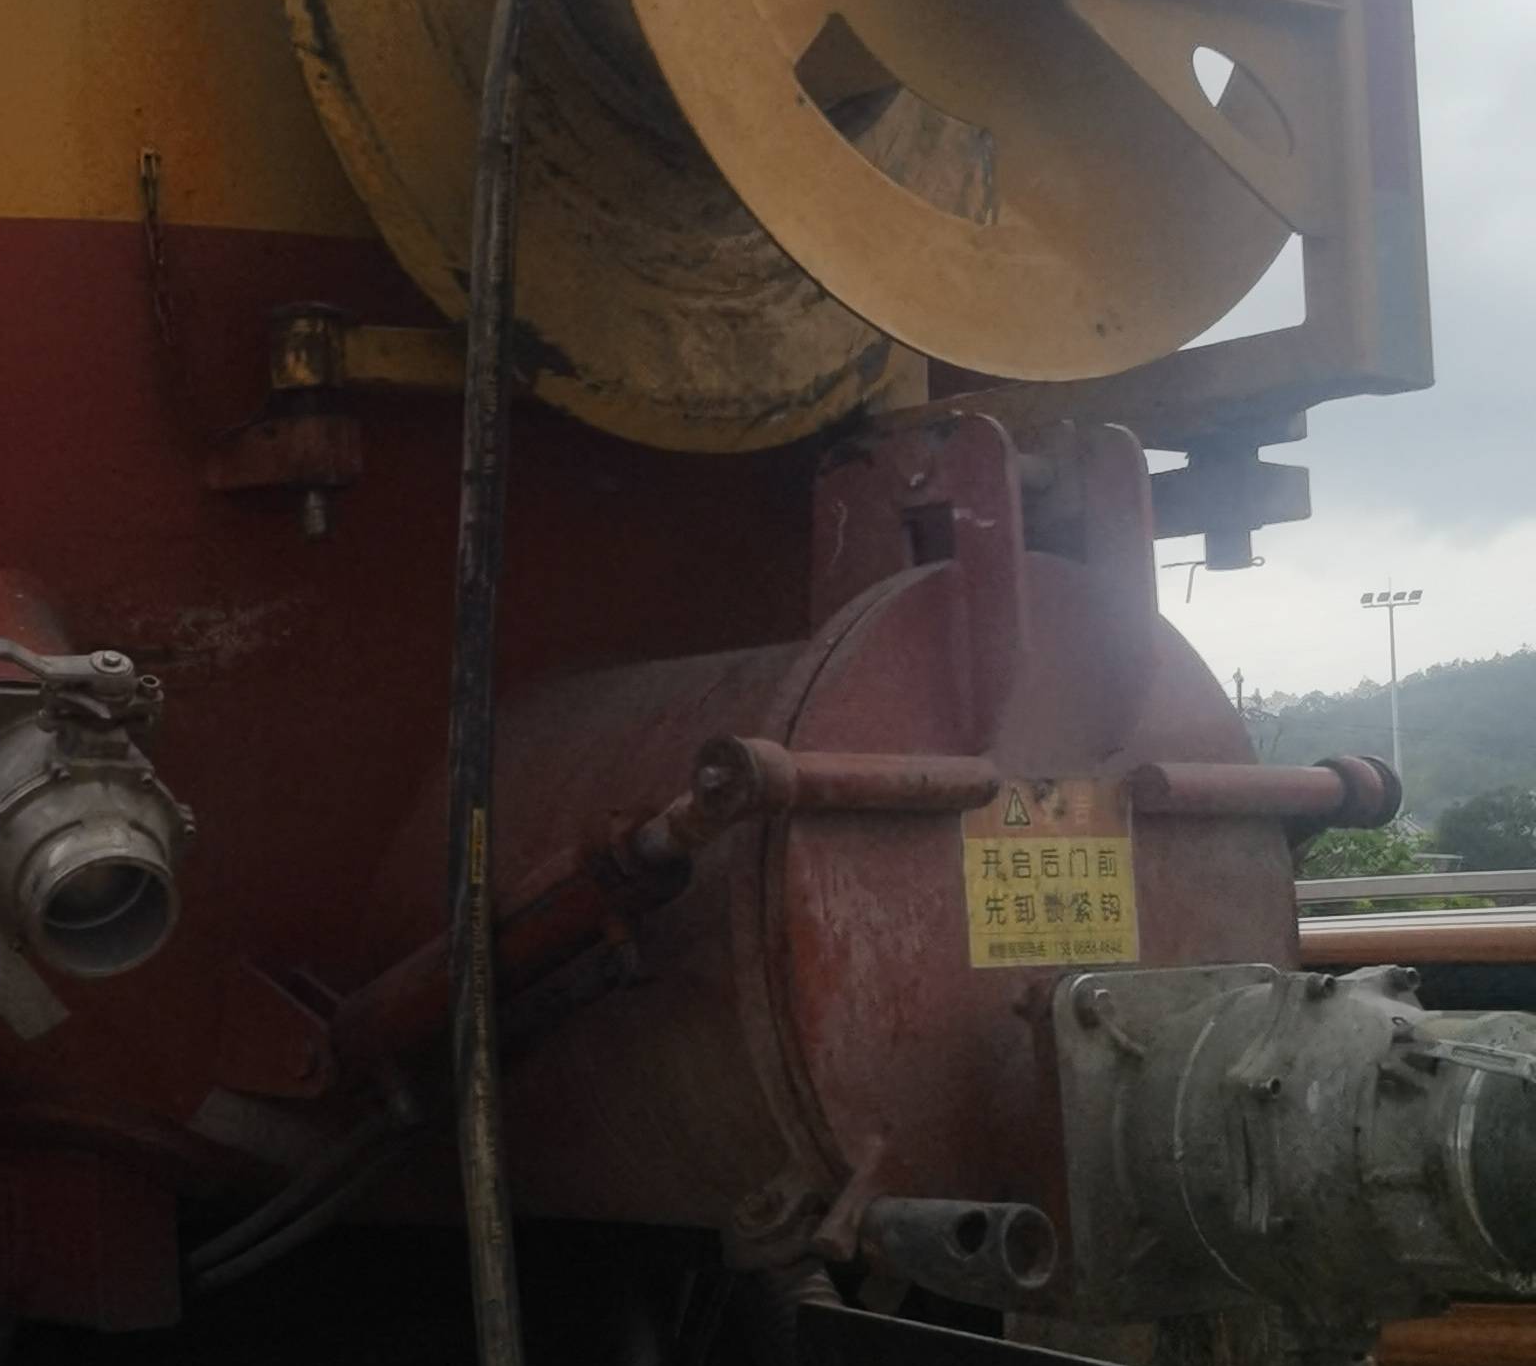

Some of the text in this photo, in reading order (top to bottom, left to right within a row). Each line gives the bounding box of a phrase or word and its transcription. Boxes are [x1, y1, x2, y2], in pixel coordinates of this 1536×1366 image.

[981, 848, 1118, 881] 开启后门前
